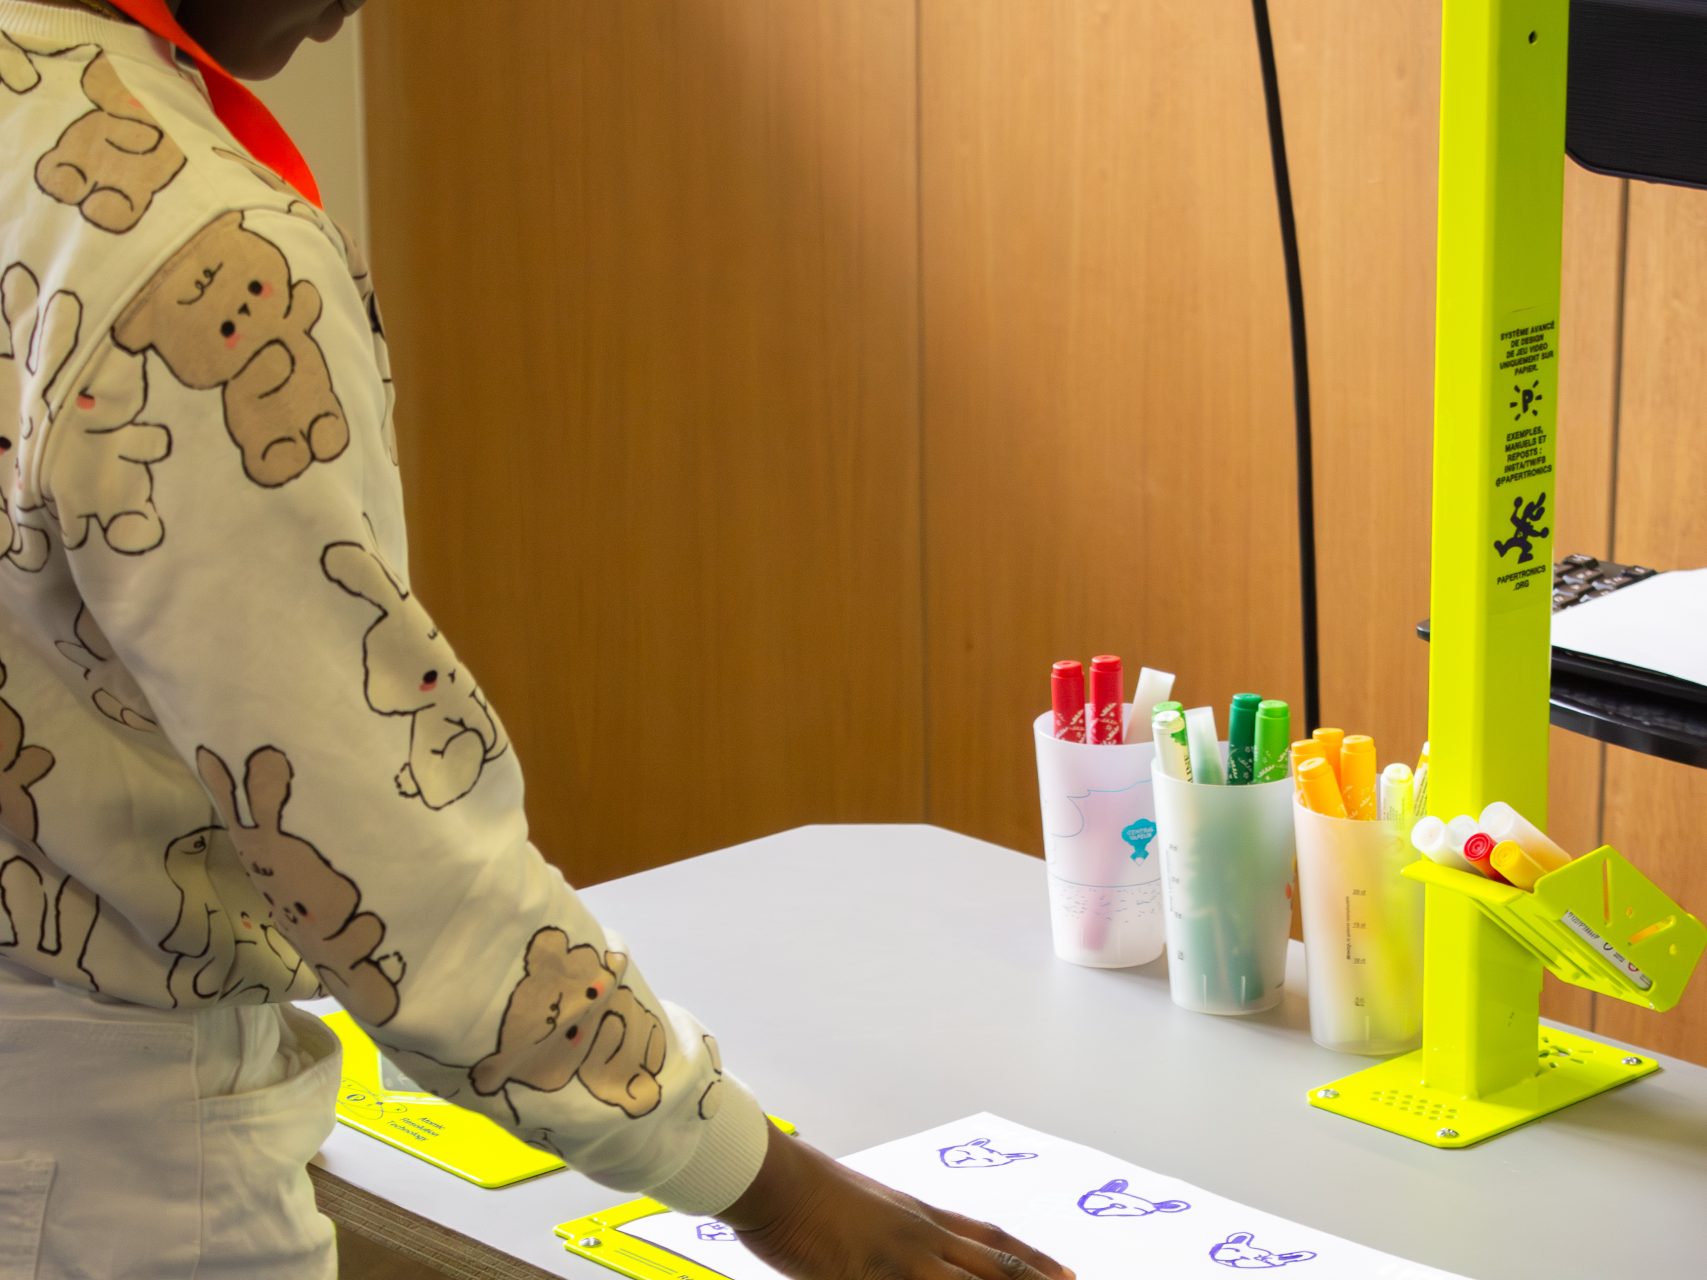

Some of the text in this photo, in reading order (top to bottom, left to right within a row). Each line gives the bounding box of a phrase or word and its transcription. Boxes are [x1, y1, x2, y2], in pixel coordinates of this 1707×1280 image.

[1510, 339, 1520, 348] DE
[1506, 350, 1515, 359] DE
[1505, 434, 1547, 452] MANUELS ET
[1507, 447, 1538, 462] REPOSTS
[1495, 464, 1552, 488] @PAPERTRONICS
[1496, 564, 1546, 585] PAPERTRONICS
